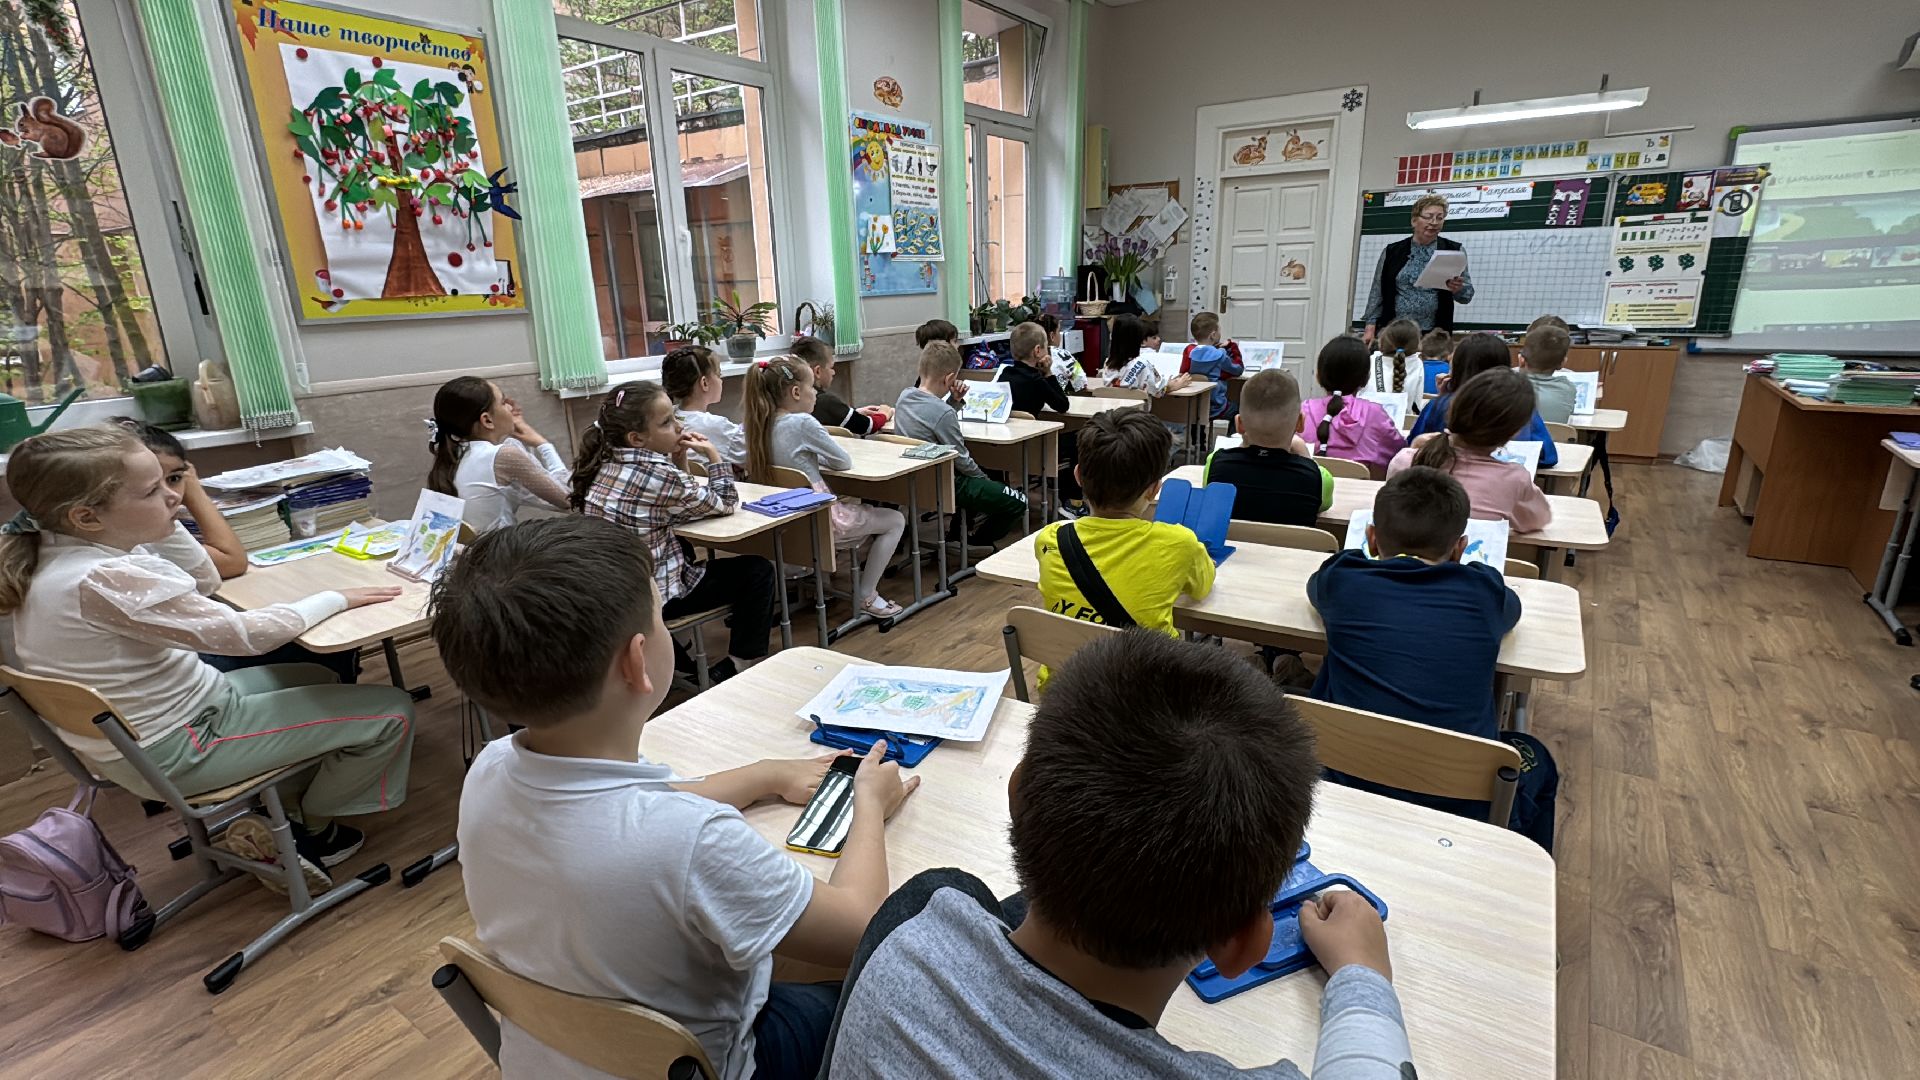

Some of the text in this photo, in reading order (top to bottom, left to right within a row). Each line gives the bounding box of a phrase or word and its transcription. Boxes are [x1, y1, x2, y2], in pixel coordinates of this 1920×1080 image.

[258, 8, 472, 61] Наше творчество
[1466, 203, 1506, 217] работа
